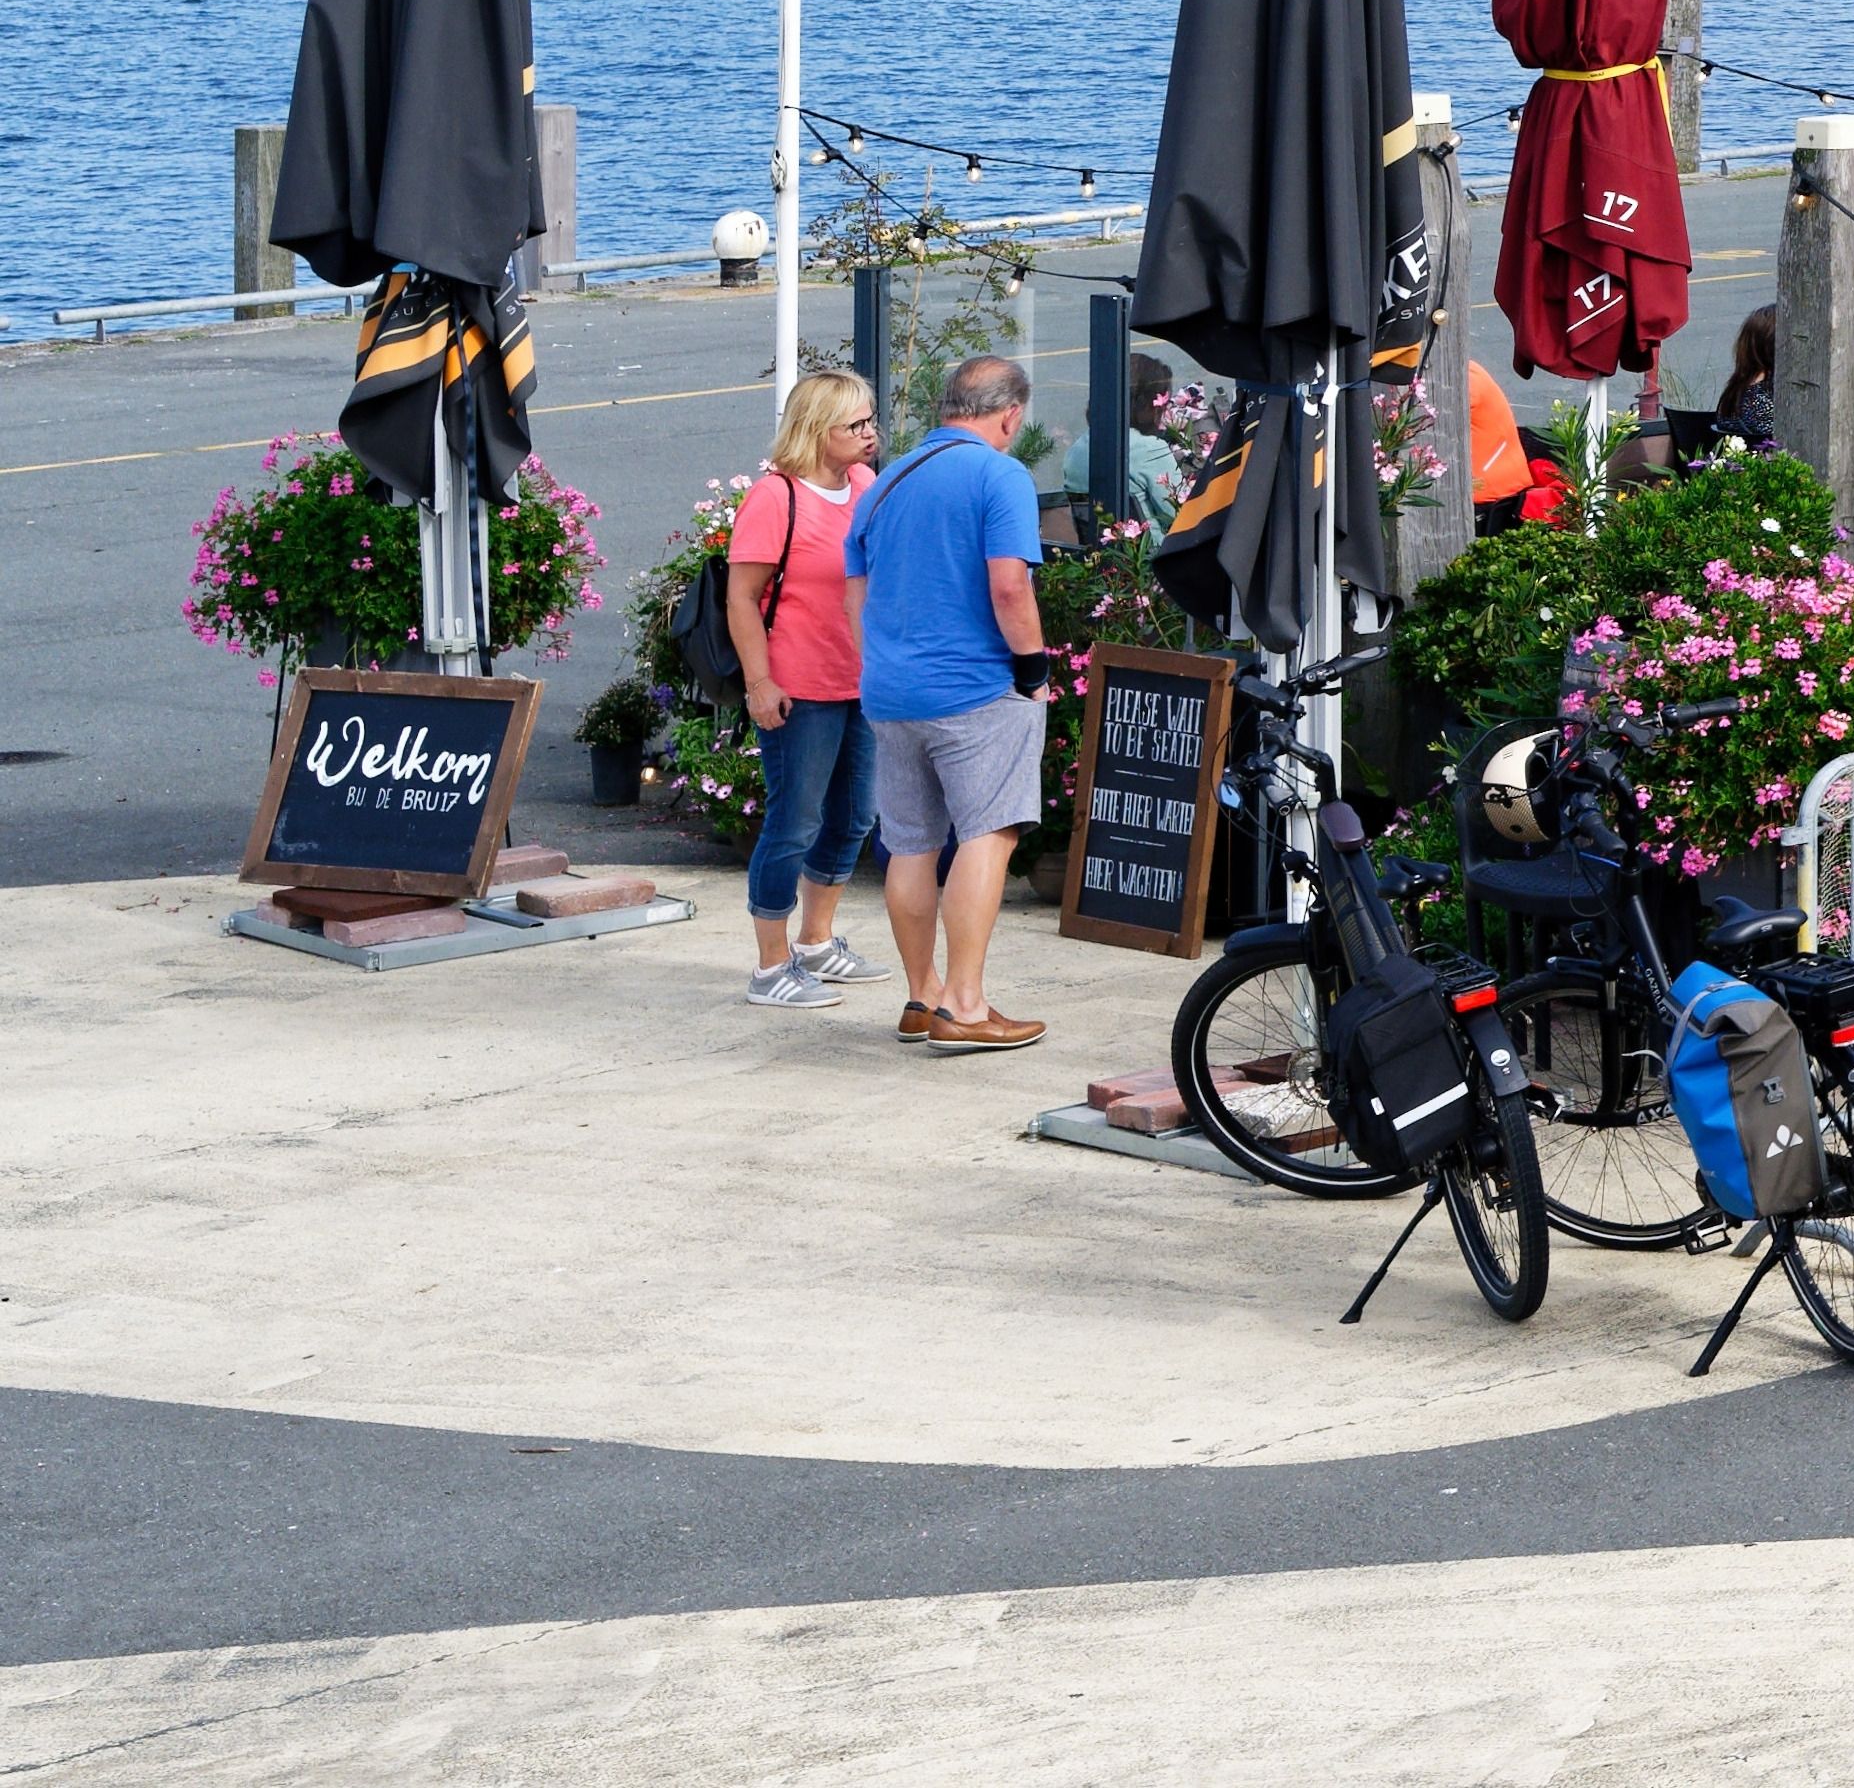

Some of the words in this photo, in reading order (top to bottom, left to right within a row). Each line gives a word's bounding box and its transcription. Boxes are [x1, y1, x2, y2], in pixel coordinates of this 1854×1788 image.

[1601, 191, 1639, 222] 17
[1573, 272, 1612, 310] 17
[1105, 686, 1162, 728] PLEASE
[1166, 693, 1205, 735] WAIT
[307, 716, 492, 805] Welkom
[1104, 721, 1122, 755] TO
[1125, 724, 1148, 760] BE
[1151, 729, 1205, 769] SEATED
[345, 785, 368, 807] BIJ
[375, 787, 394, 810] DE
[1091, 787, 1122, 825] BITTE
[1122, 791, 1153, 829] HIER
[1085, 856, 1115, 892] HIER
